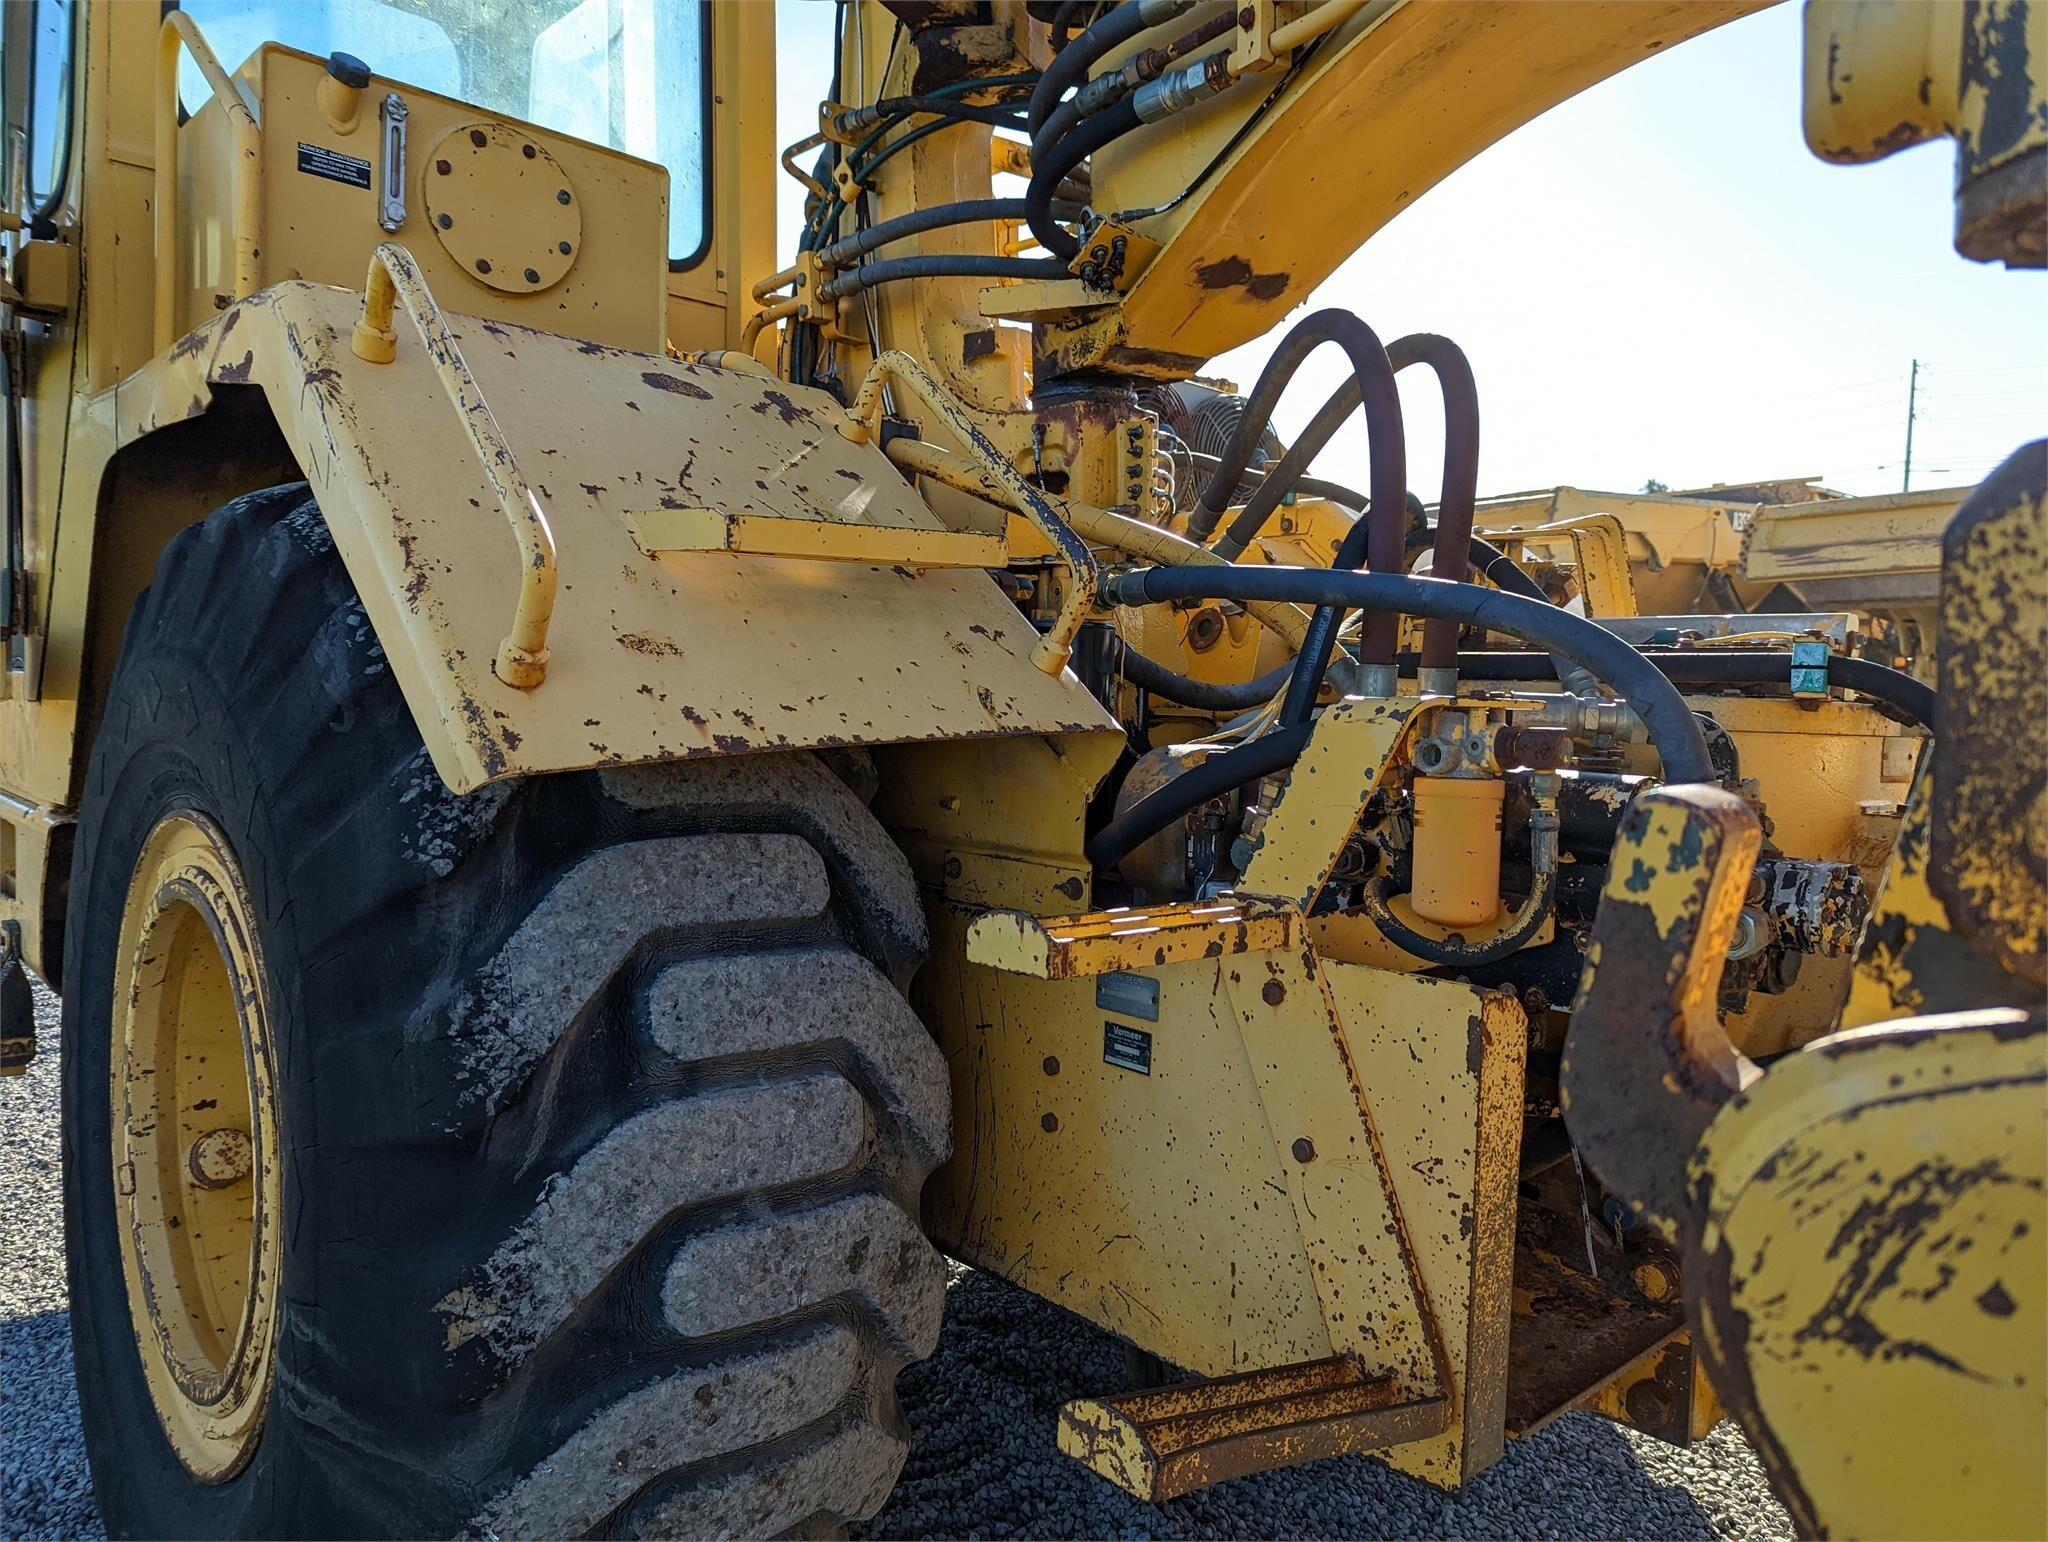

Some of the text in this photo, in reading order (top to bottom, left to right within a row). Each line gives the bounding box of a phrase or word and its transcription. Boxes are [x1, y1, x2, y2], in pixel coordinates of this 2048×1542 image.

[300, 144, 369, 166] PERIODIC MAINTENANCE
[1113, 1025, 1142, 1040] Vermeer
